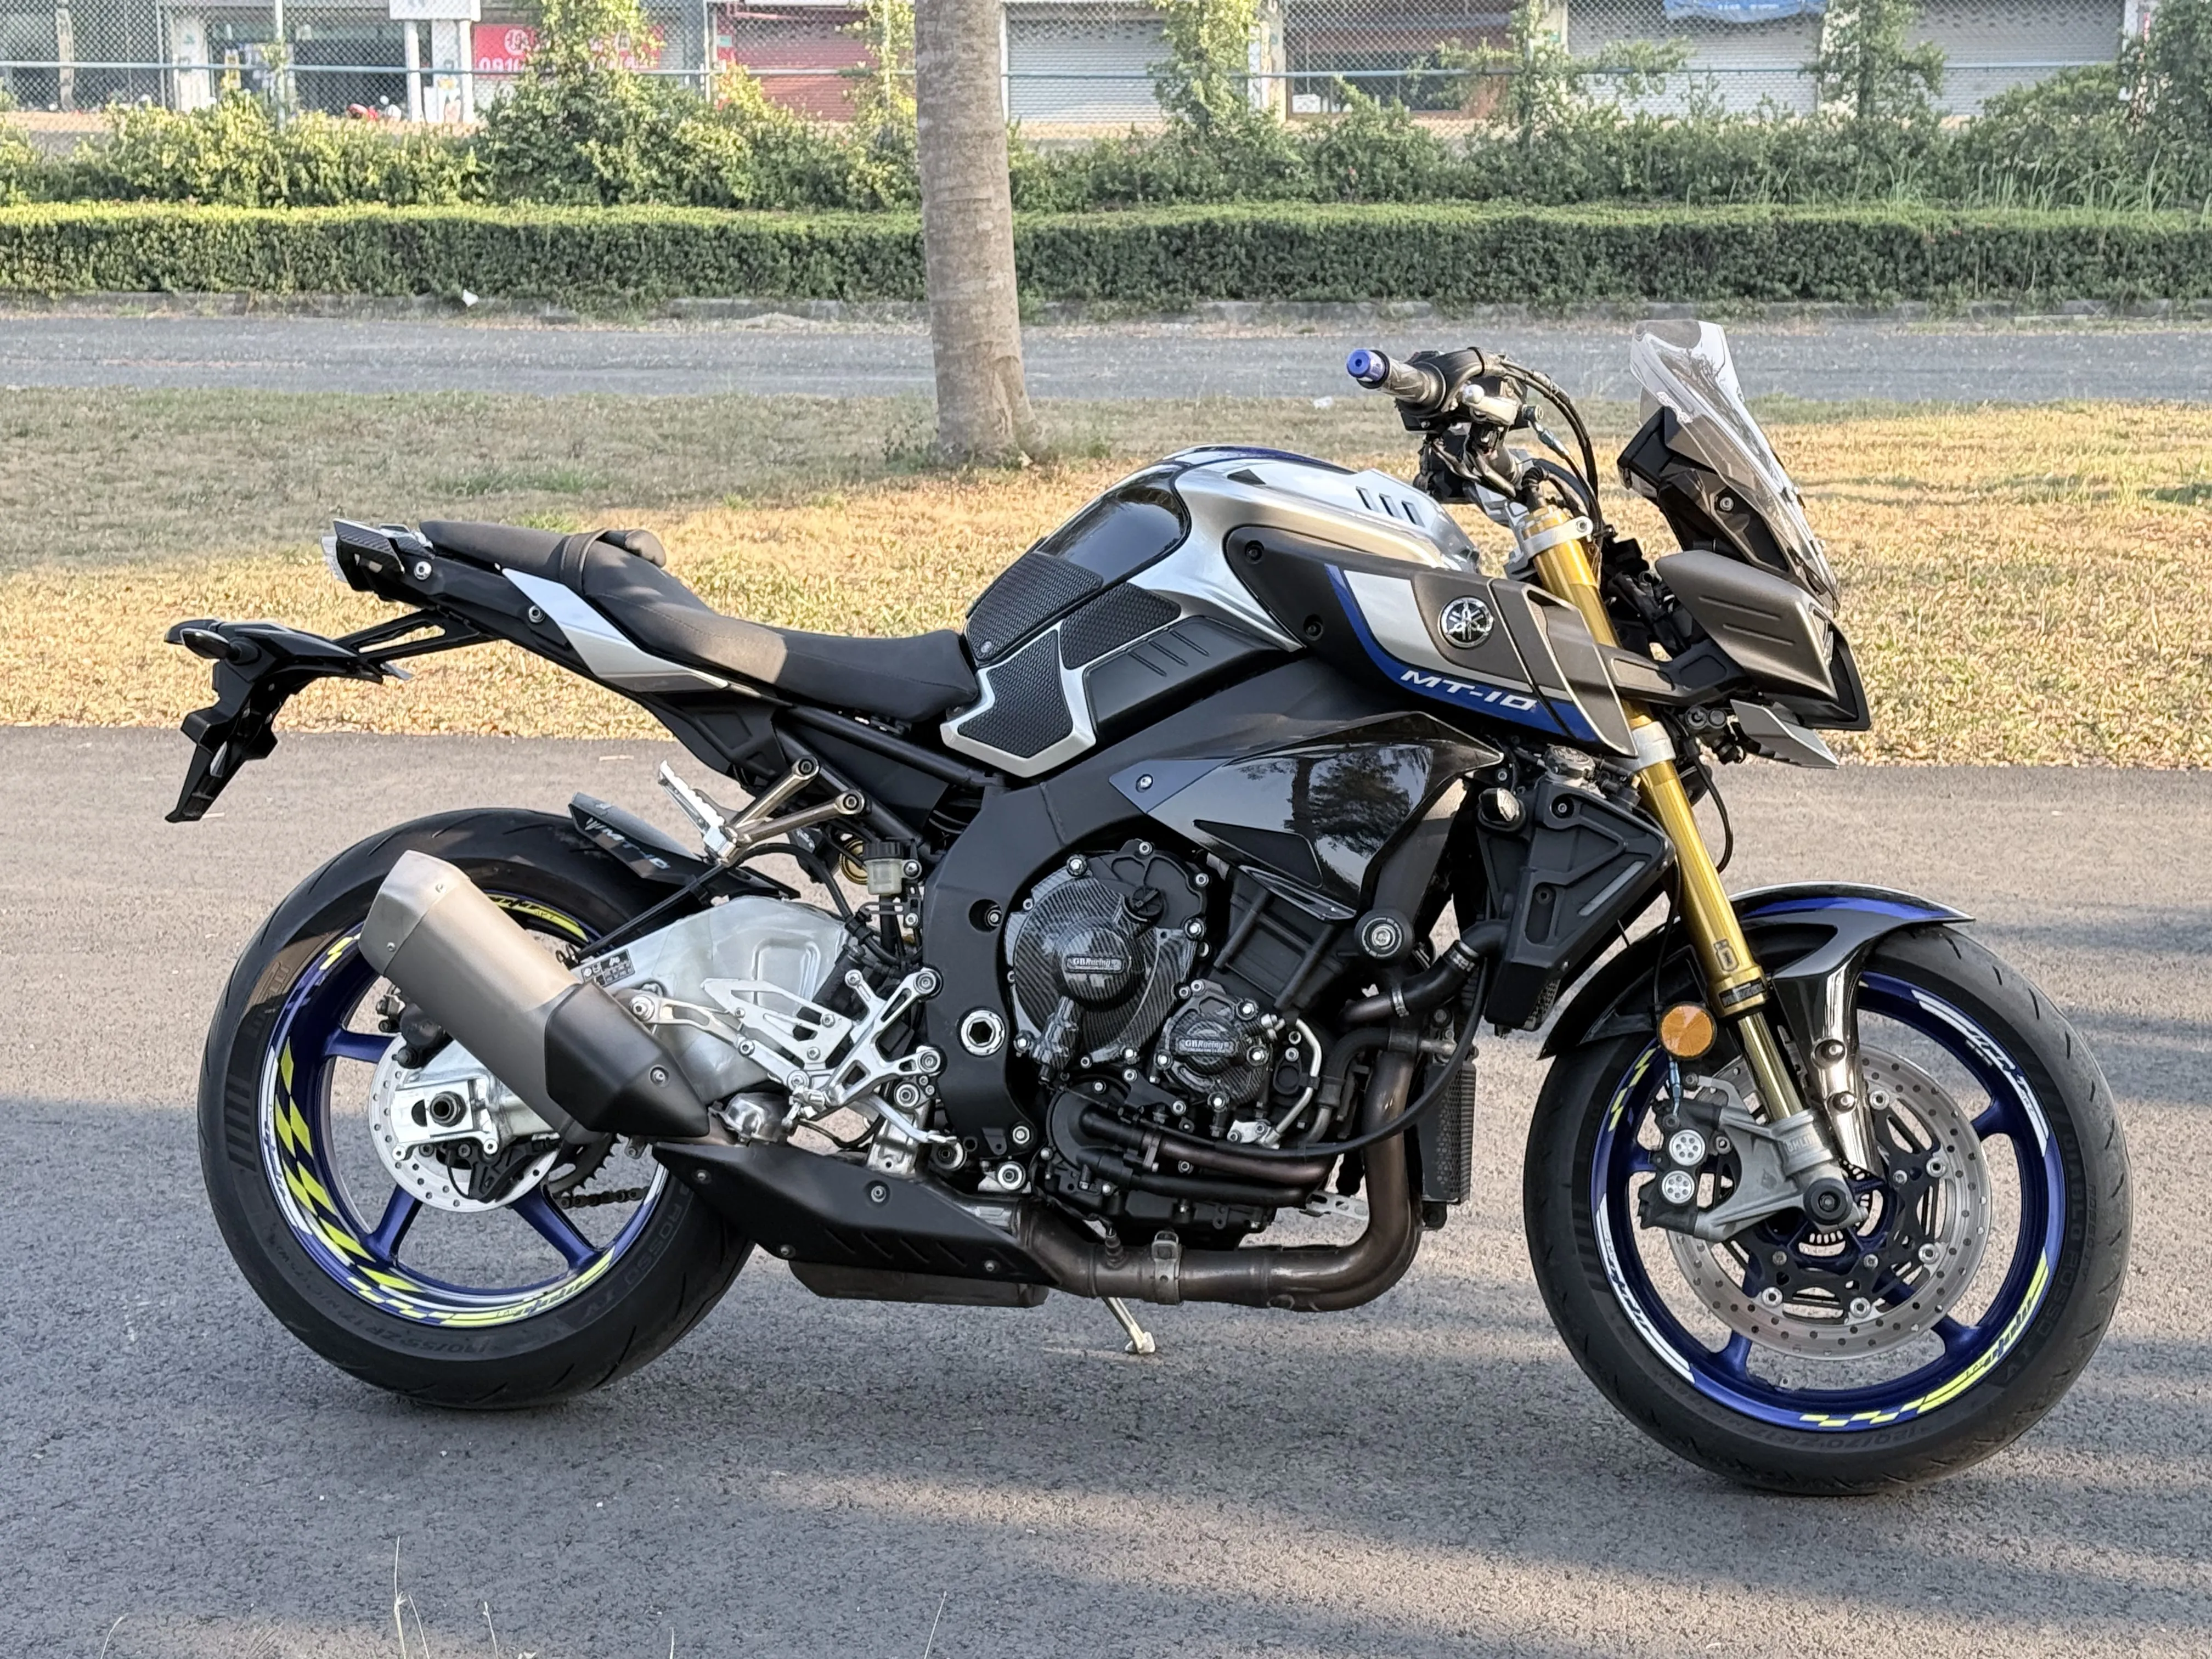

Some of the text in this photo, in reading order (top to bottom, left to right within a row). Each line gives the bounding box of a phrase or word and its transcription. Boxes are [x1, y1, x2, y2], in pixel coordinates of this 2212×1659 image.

[1400, 670, 1537, 711] MT-10
[1073, 957, 1111, 968] GBRacing
[2063, 1133, 2084, 1240] DIABLO
[624, 1204, 682, 1285] ROSSO
[2036, 1250, 2079, 1337] ROSSO
